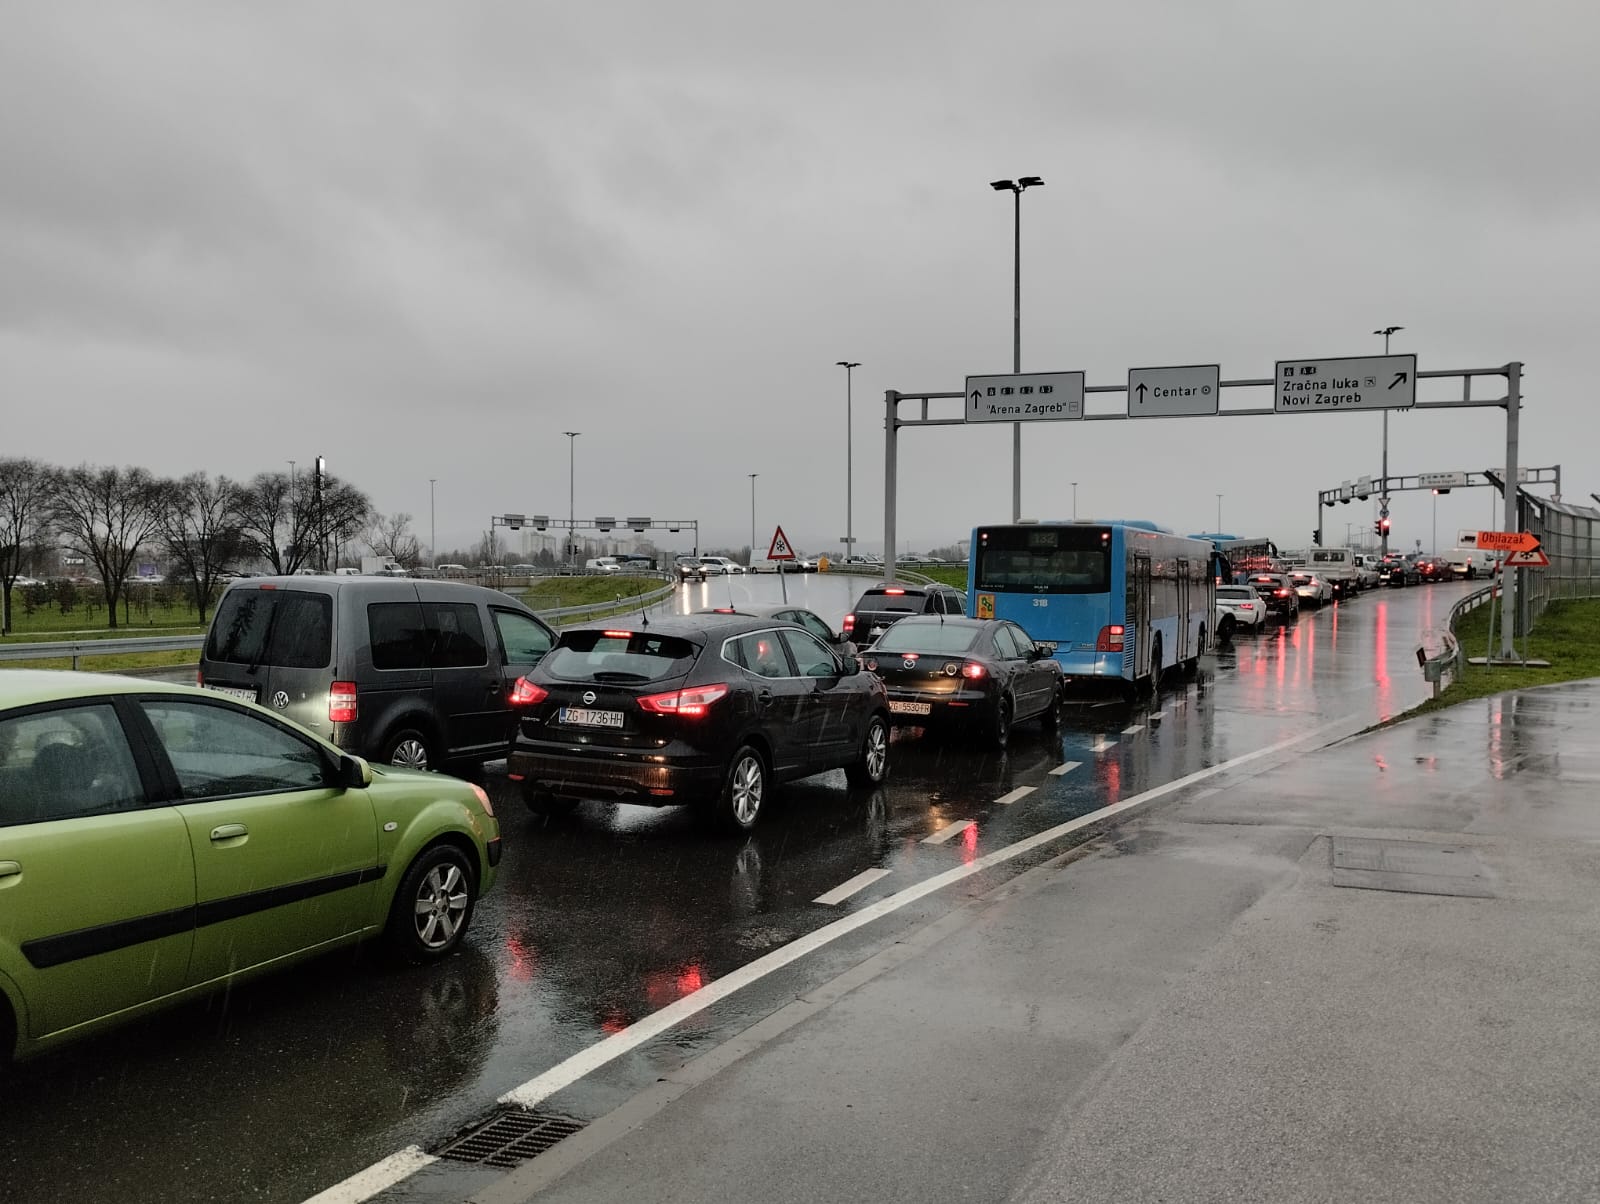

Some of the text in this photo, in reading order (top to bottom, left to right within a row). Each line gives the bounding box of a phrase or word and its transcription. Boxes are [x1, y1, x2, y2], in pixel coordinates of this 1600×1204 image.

[1283, 378, 1359, 391] Zračna luka
[1154, 386, 1197, 397] Centar
[1282, 392, 1361, 406] Novi Zagreb
[1482, 532, 1524, 544] Obilazak
[1032, 598, 1048, 607] 318
[566, 709, 578, 721] ZG
